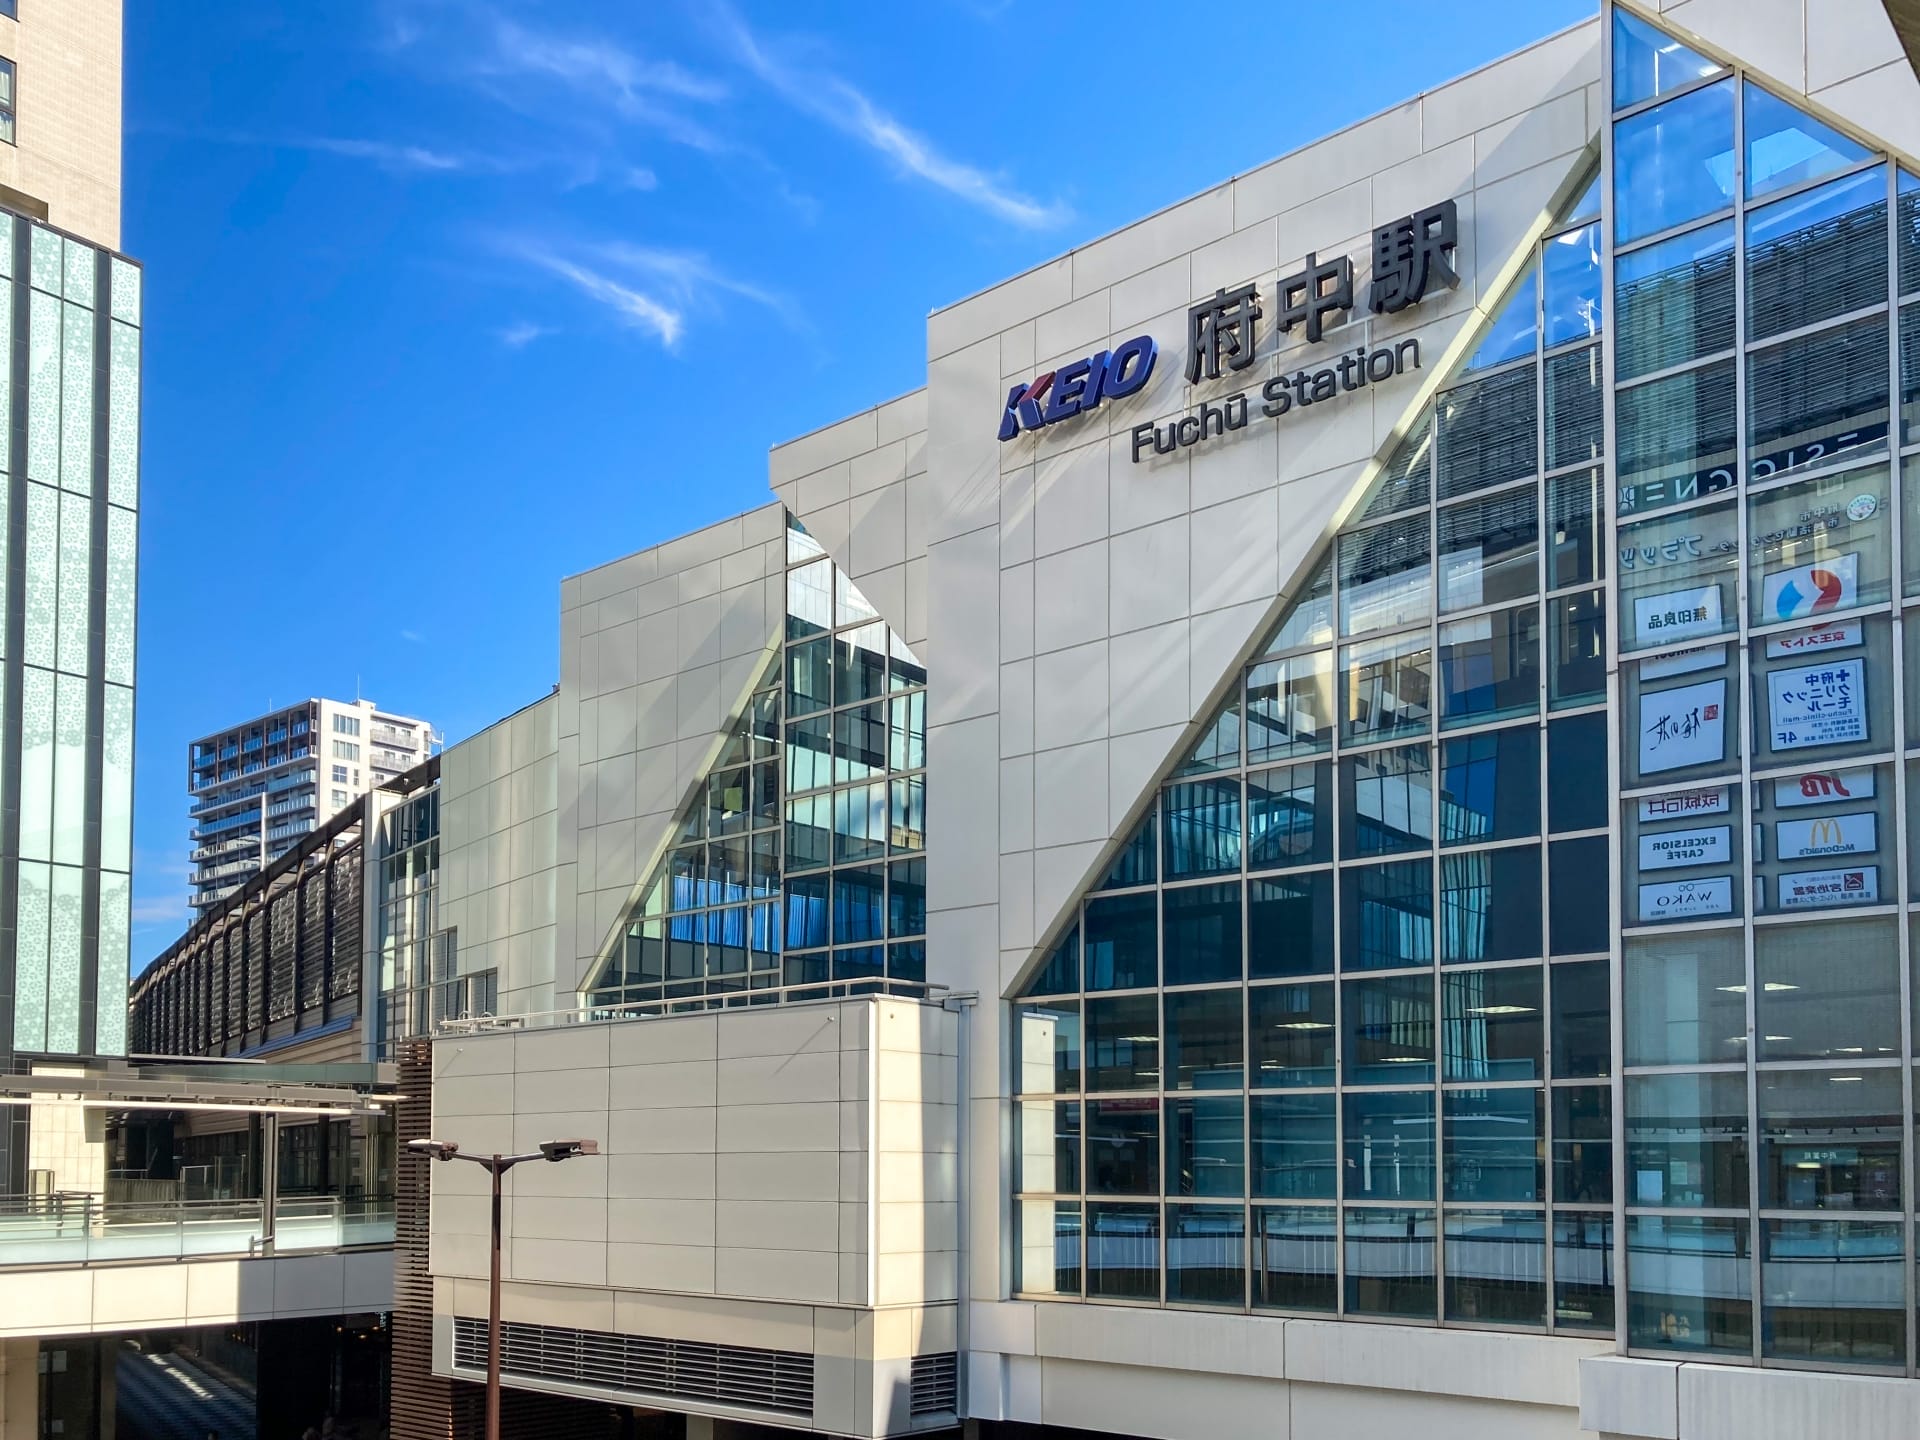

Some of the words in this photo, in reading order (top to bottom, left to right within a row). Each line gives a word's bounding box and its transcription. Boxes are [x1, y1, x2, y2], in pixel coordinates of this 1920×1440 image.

[998, 335, 1159, 441] KEIO
[1185, 199, 1460, 385] 府中駅
[1131, 393, 1248, 462] Fuchū
[1262, 337, 1422, 418] Station
